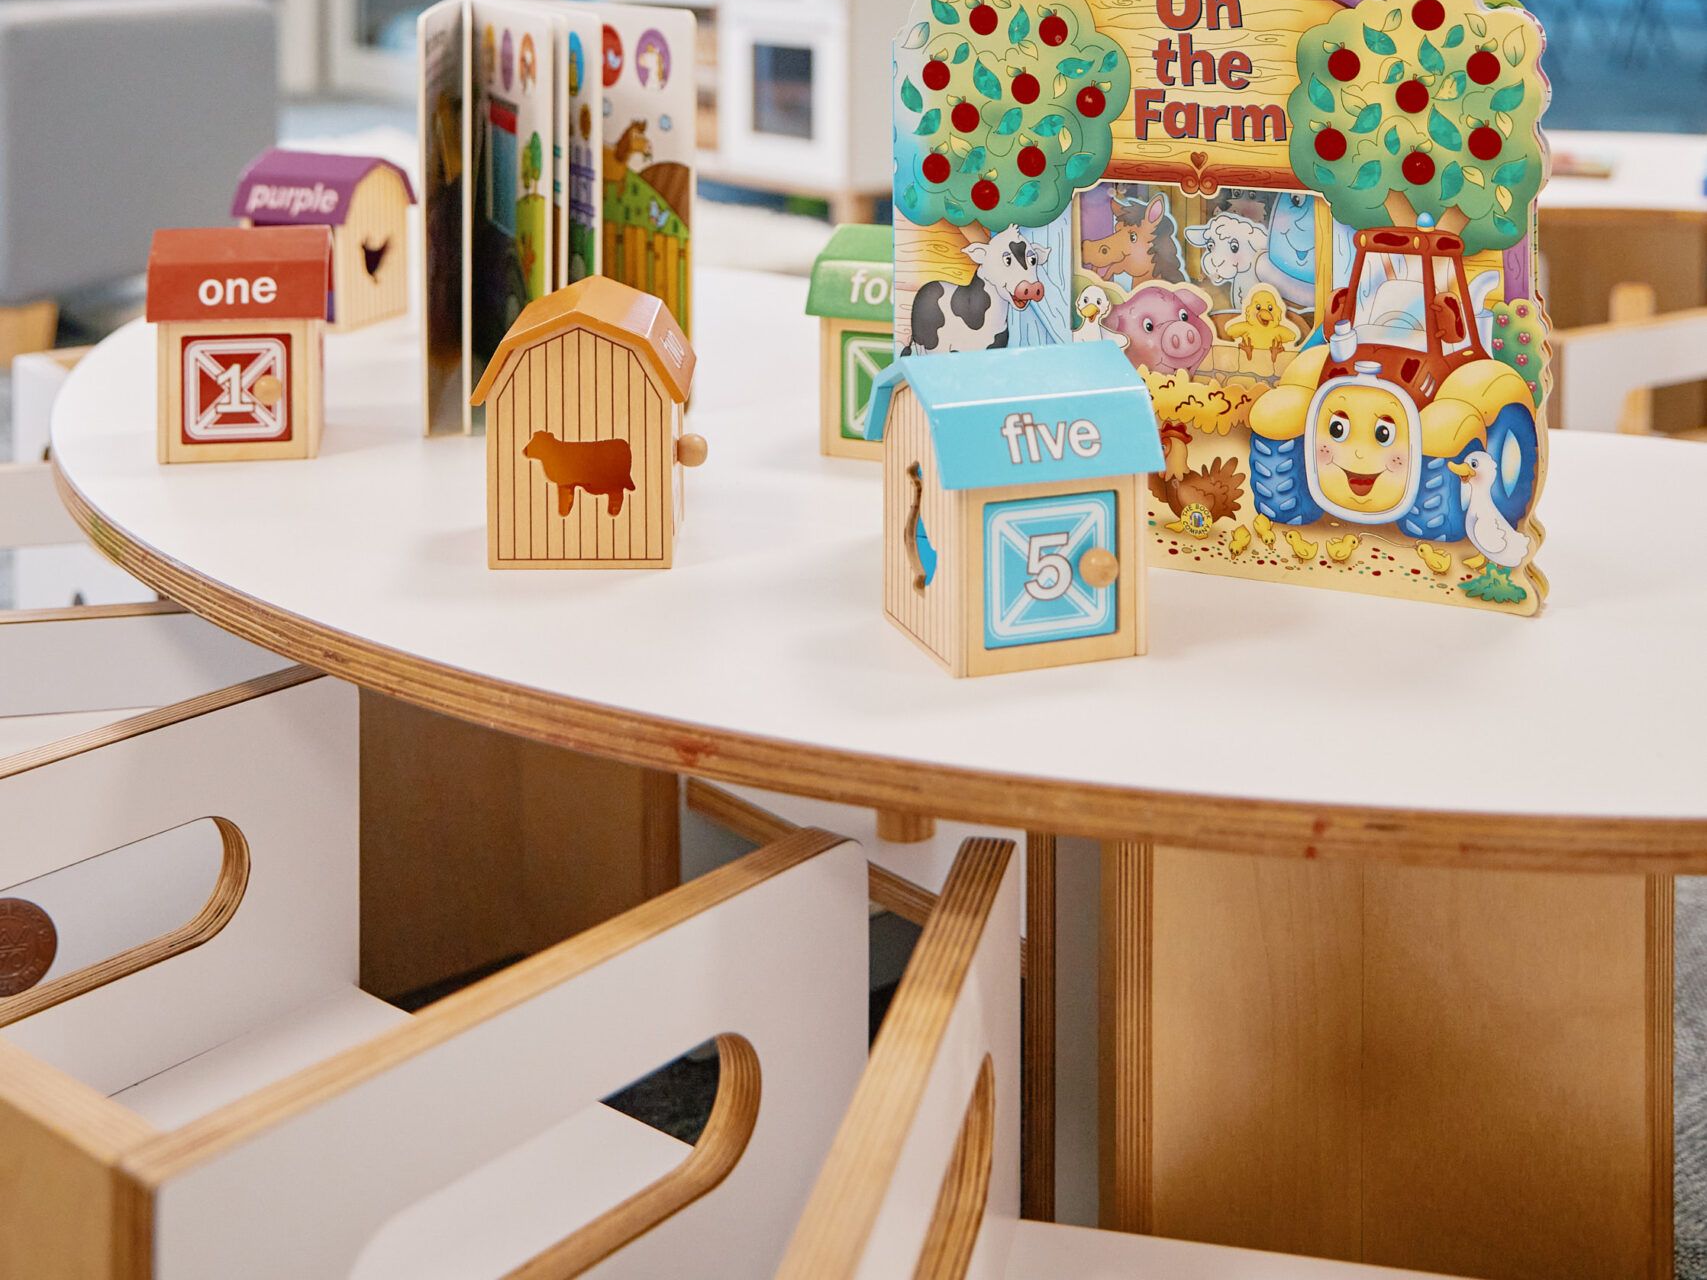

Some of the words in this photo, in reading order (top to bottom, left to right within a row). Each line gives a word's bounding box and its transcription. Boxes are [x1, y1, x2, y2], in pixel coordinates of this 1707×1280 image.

[1152, 33, 1253, 91] the
[1134, 88, 1287, 142] Farm
[245, 182, 339, 217] purple
[198, 276, 278, 307] one
[850, 268, 895, 305] fo
[215, 363, 256, 414] 1
[1001, 412, 1102, 465] five
[1183, 505, 1193, 516] THE
[1196, 504, 1211, 518] BOOK
[1024, 531, 1074, 602] 5
